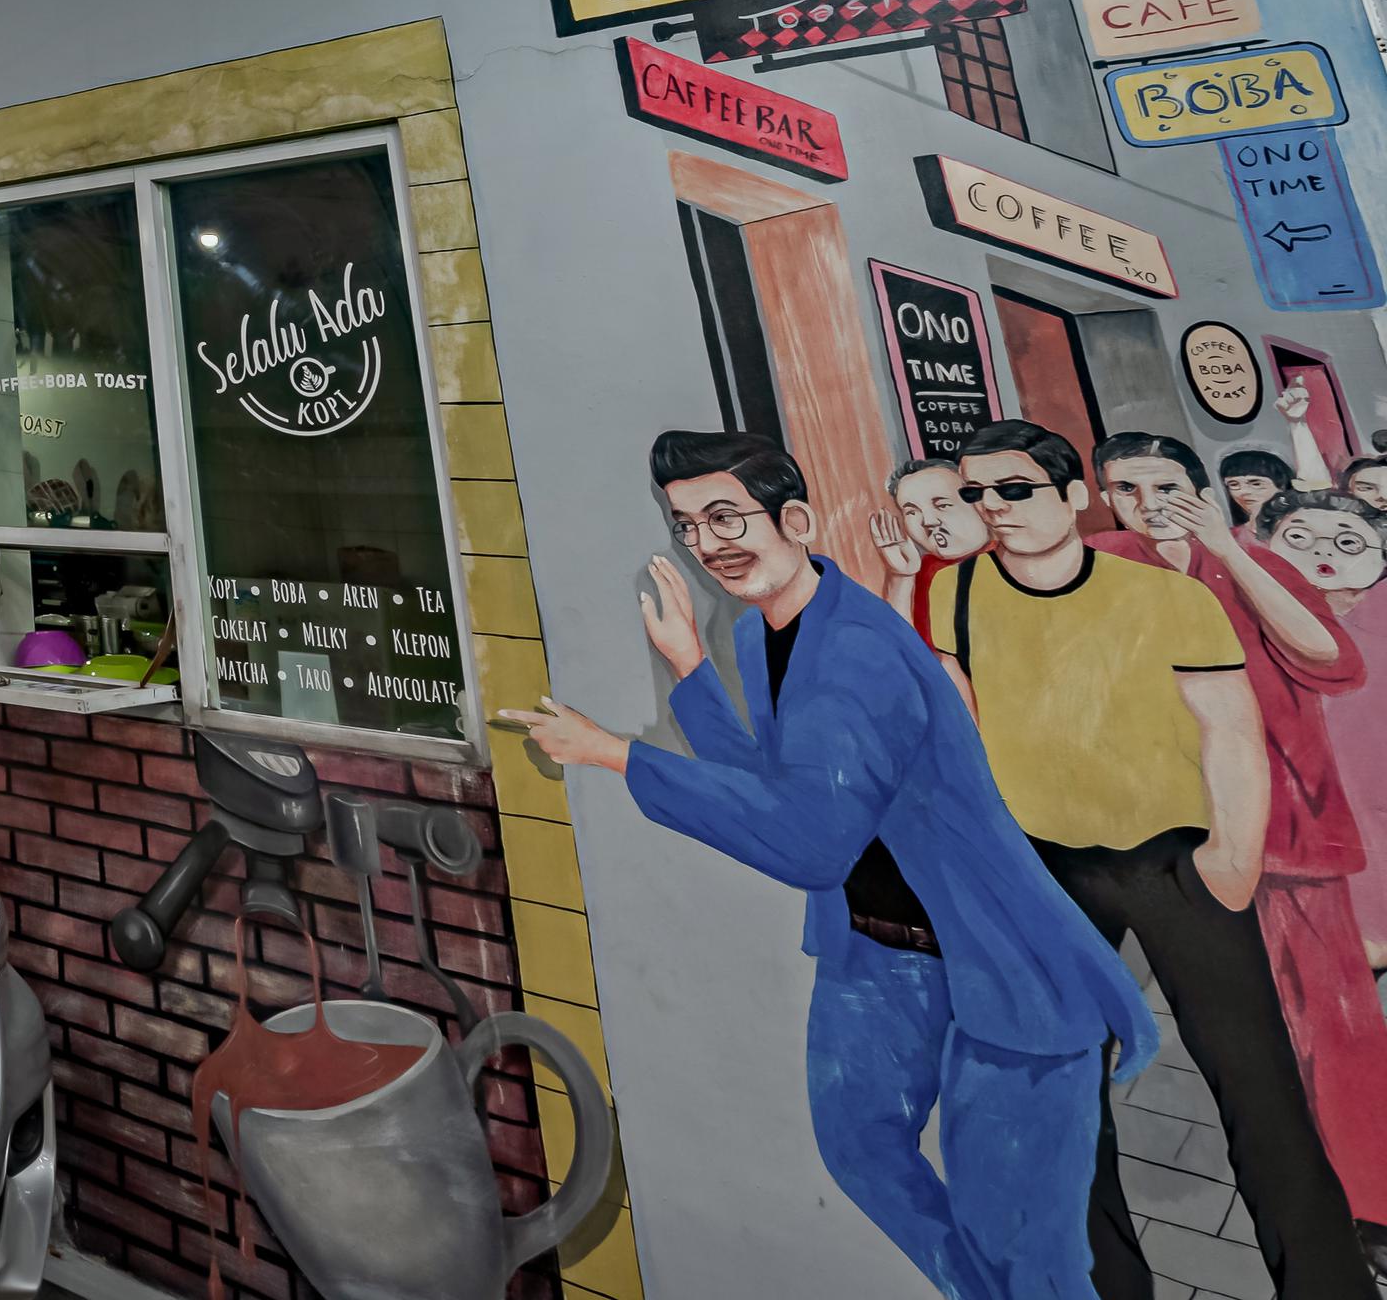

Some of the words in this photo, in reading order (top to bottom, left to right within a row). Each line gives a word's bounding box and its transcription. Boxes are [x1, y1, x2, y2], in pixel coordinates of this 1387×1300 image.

[641, 63, 747, 127] CAFFEE
[756, 104, 827, 150] BAR
[1134, 67, 1315, 119] BOBA
[1237, 140, 1320, 167] ONO
[1243, 175, 1326, 198] TIME
[967, 182, 1131, 264] COFFEE
[197, 299, 307, 394] Selalu
[308, 262, 385, 342] Ada
[897, 302, 970, 344] ONO
[1190, 341, 1236, 356] COFFEE
[94, 372, 148, 391] TOAST
[906, 359, 977, 385] TIME
[1198, 363, 1246, 375] BOBA
[1203, 385, 1247, 399] TOAST
[297, 389, 357, 426] KOPI
[917, 401, 980, 415] COFFEE
[20, 414, 65, 437] OAST
[925, 420, 975, 433] BOBA
[207, 575, 240, 600] KOPI
[271, 579, 307, 605] BOBA
[343, 582, 379, 609] AREN
[416, 586, 446, 614] TEA
[211, 615, 268, 643] COKELAT
[302, 621, 348, 650] MILKY
[392, 628, 451, 659] KLEPON
[216, 656, 269, 685] MATCHA
[296, 663, 331, 692] TARO
[368, 671, 458, 706] ALPOCOLATE
